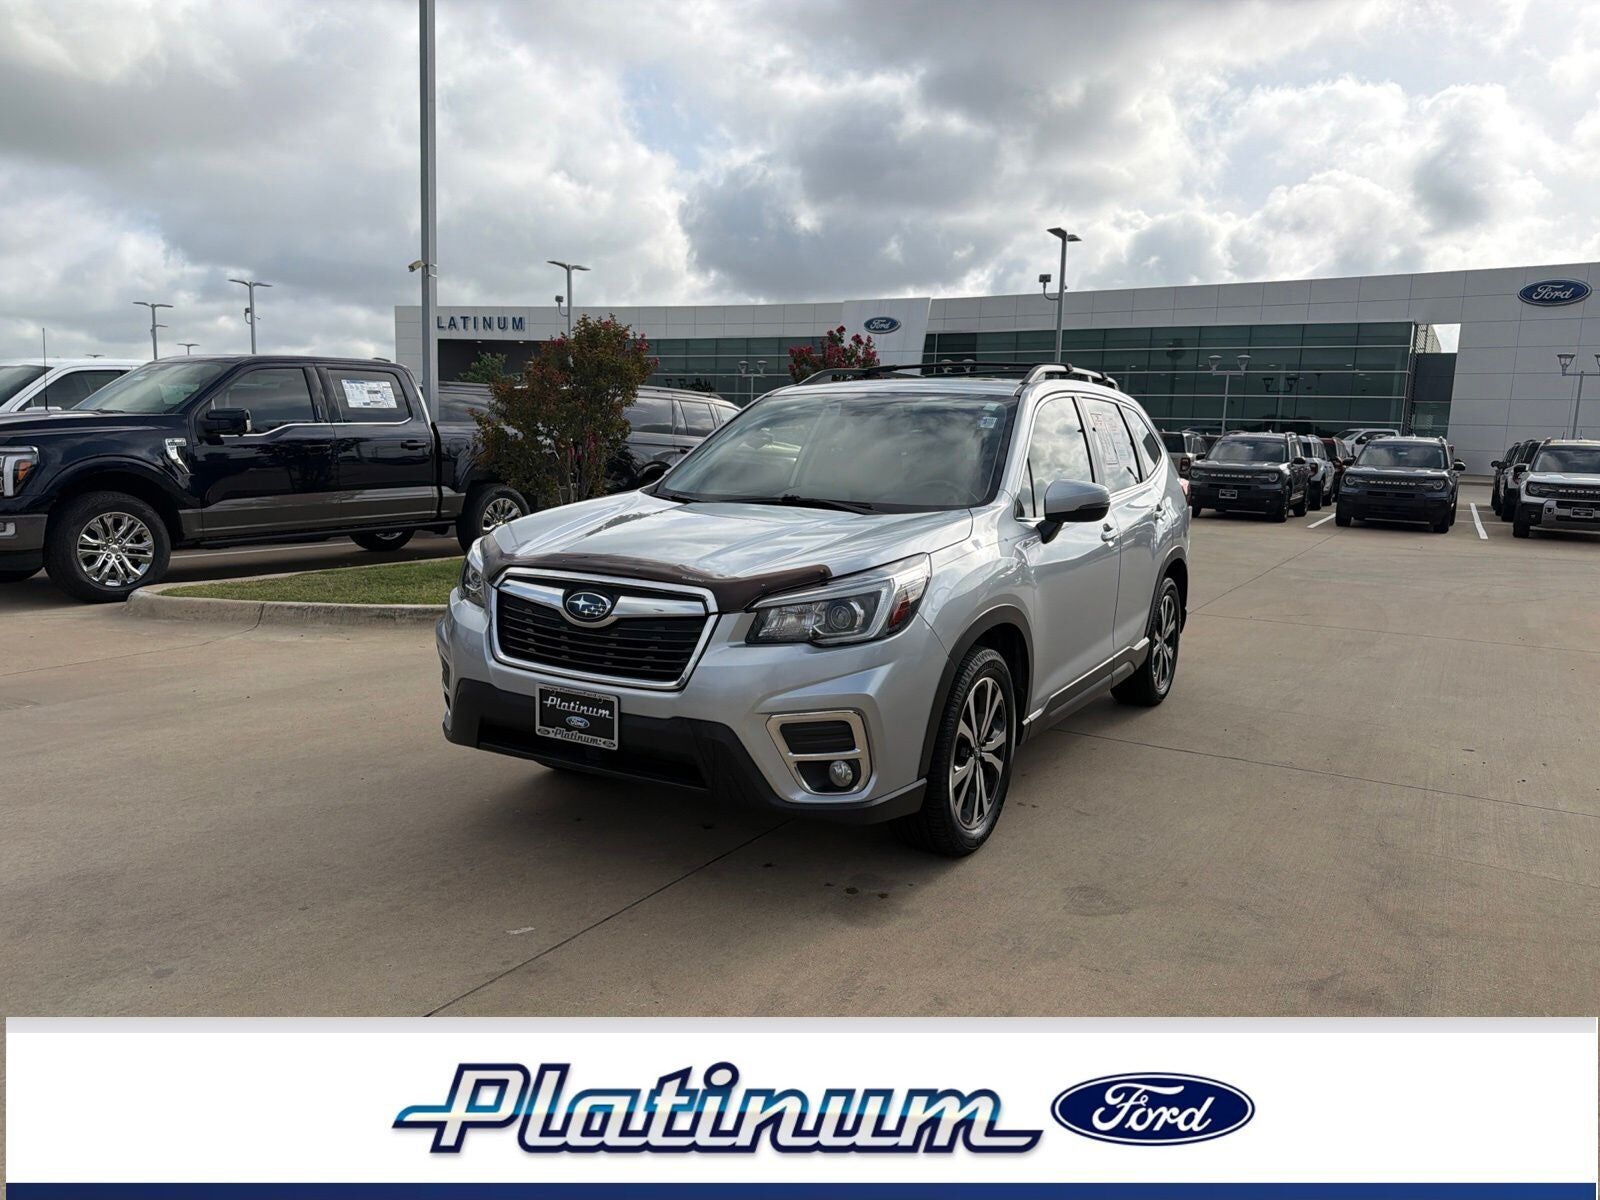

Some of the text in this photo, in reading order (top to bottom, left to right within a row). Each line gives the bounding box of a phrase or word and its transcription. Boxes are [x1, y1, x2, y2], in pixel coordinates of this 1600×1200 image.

[1532, 284, 1575, 300] Ford
[436, 315, 525, 332] LATINUM
[870, 319, 892, 330] Ford
[542, 696, 614, 719] Platinum
[554, 728, 602, 746] Platinum
